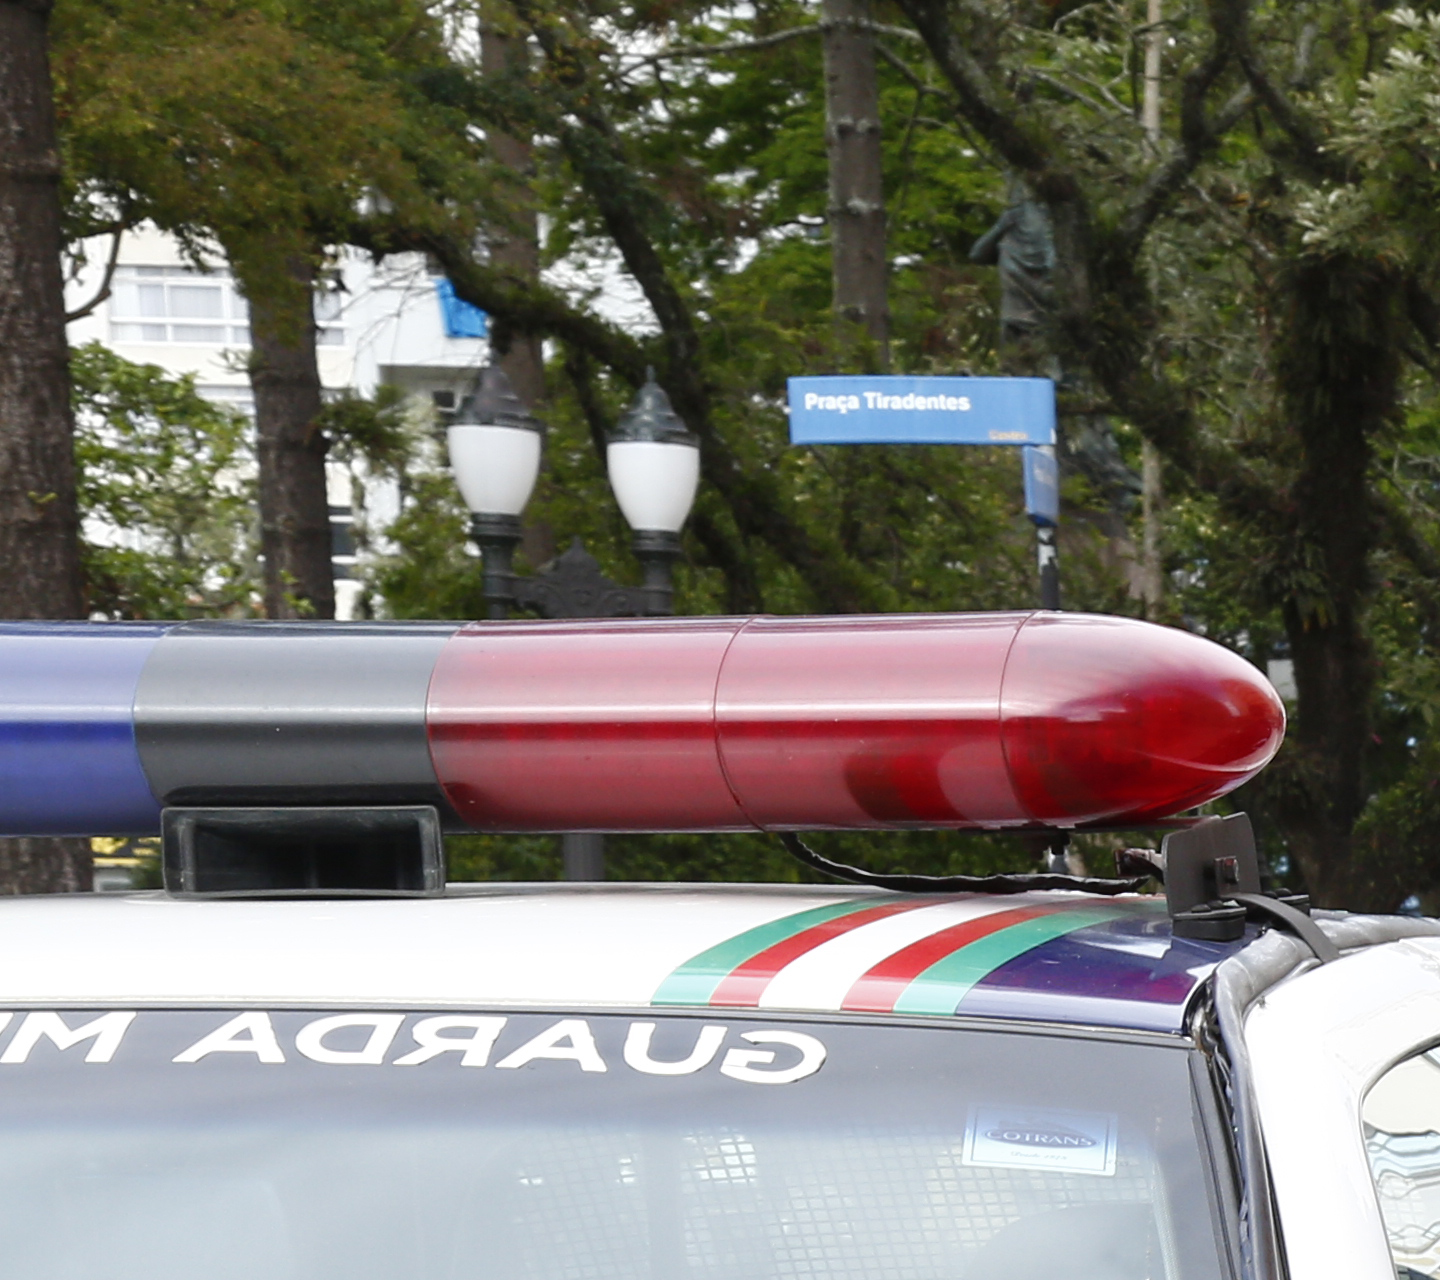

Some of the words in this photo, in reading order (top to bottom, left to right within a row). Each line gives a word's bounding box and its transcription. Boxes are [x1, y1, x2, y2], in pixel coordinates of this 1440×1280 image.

[804, 392, 860, 414] Praça
[862, 391, 972, 411] Tiradentes
[987, 1130, 1093, 1147] COTRANS
